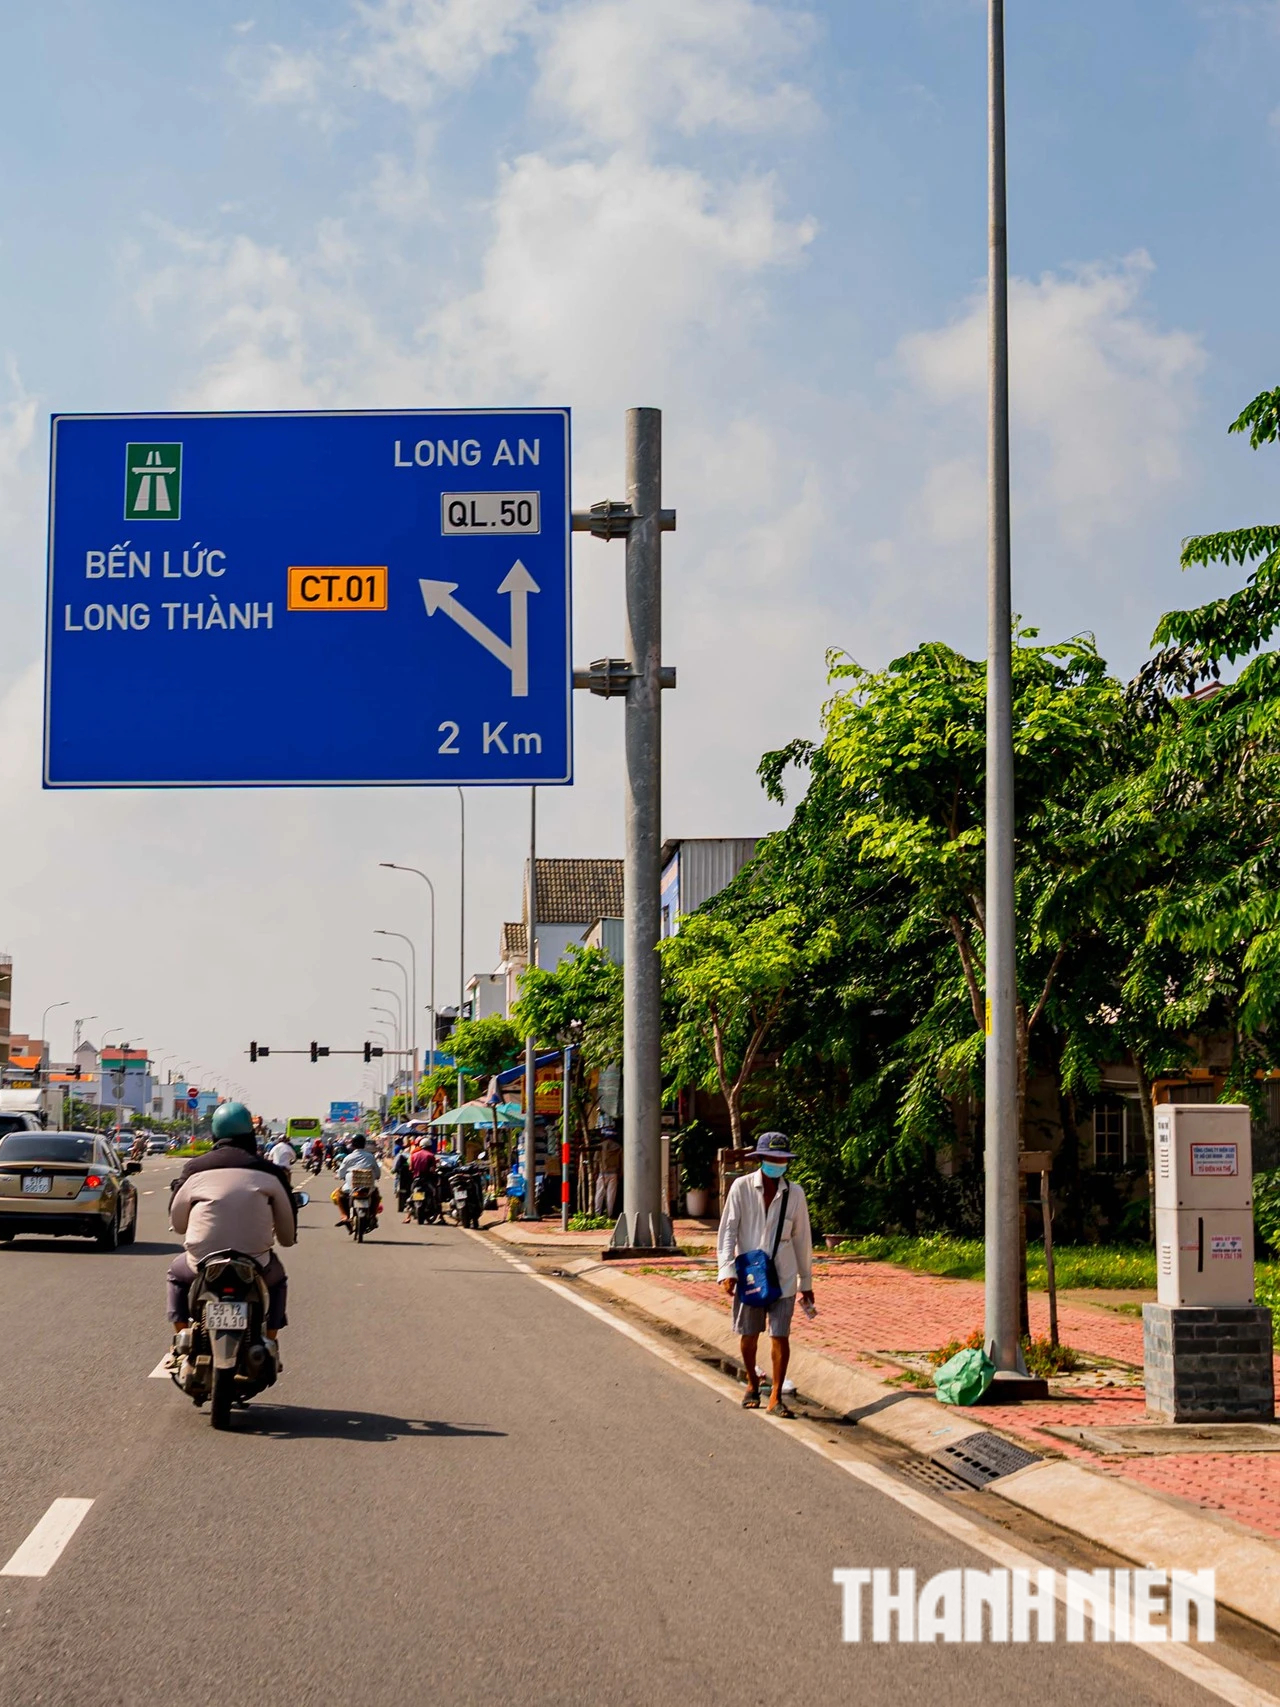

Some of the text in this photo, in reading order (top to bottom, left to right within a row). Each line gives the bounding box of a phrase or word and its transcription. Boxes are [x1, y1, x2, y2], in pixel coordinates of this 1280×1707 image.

[394, 438, 540, 467] LONG AN
[448, 499, 532, 528] QL.50
[86, 540, 226, 579] BẾN LỨC
[300, 575, 375, 603] CT.01
[64, 594, 273, 631] LONG THÀNH
[438, 720, 542, 755] 2 Km
